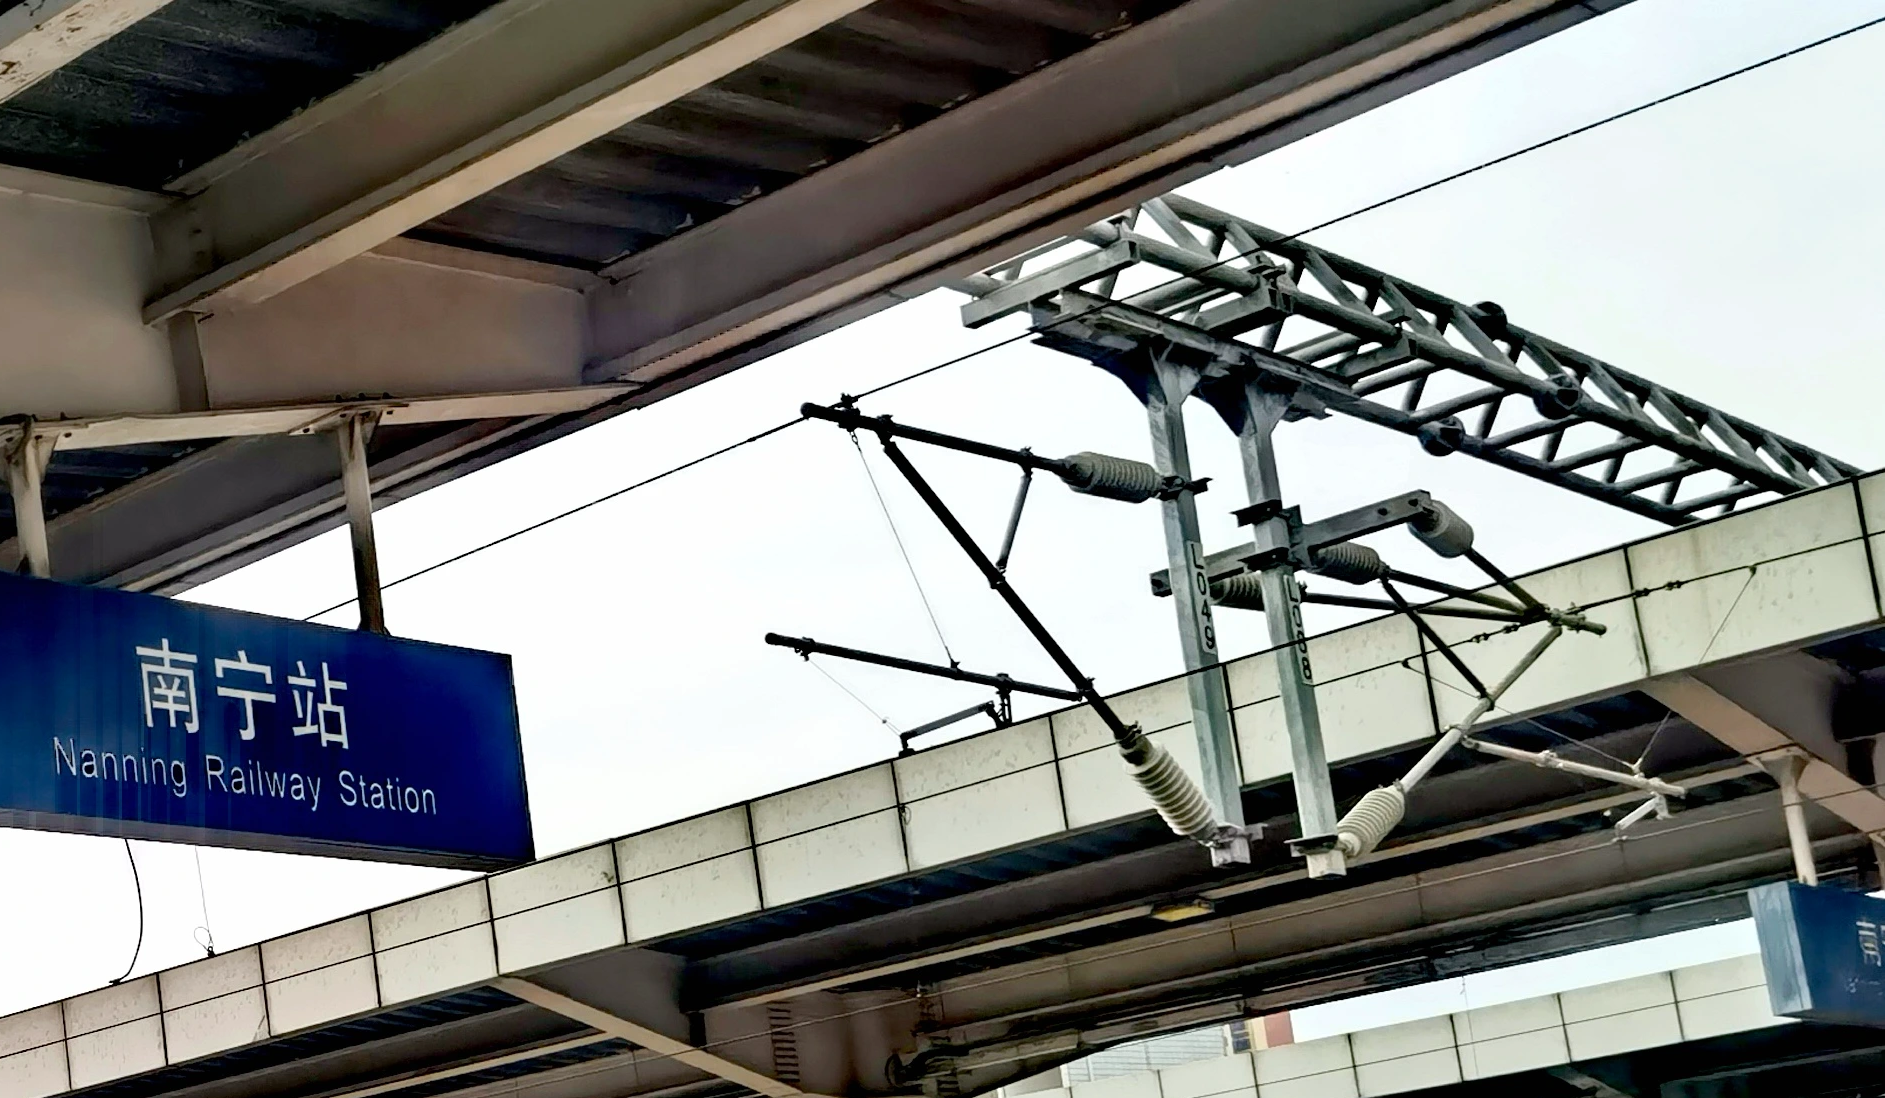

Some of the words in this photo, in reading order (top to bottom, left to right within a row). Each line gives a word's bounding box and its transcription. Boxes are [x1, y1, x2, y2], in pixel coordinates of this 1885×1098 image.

[1190, 543, 1215, 650] L049
[135, 637, 349, 750] 南宁站
[52, 736, 188, 798] Nanning
[204, 754, 322, 812] Railway
[337, 770, 437, 815] Station
